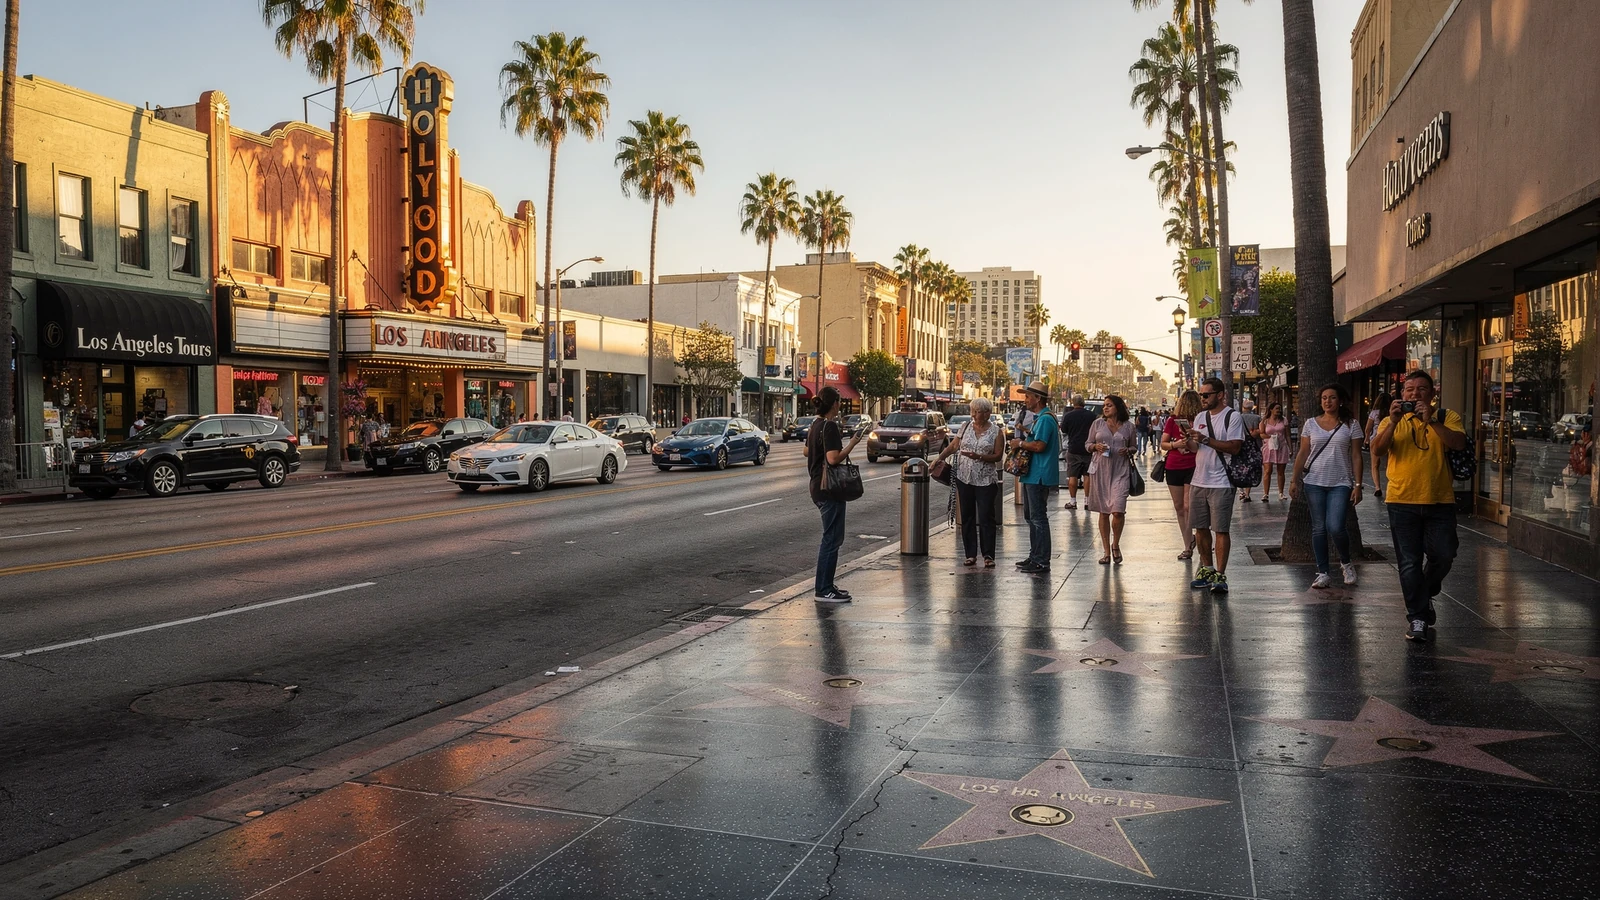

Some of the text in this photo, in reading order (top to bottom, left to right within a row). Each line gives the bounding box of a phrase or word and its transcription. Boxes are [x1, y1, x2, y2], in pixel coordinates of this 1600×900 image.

[412, 78, 437, 295] HOLYOOD
[77, 327, 212, 357] Los Angeles Tours
[375, 324, 408, 347] LOS
[959, 782, 999, 794] LOS
